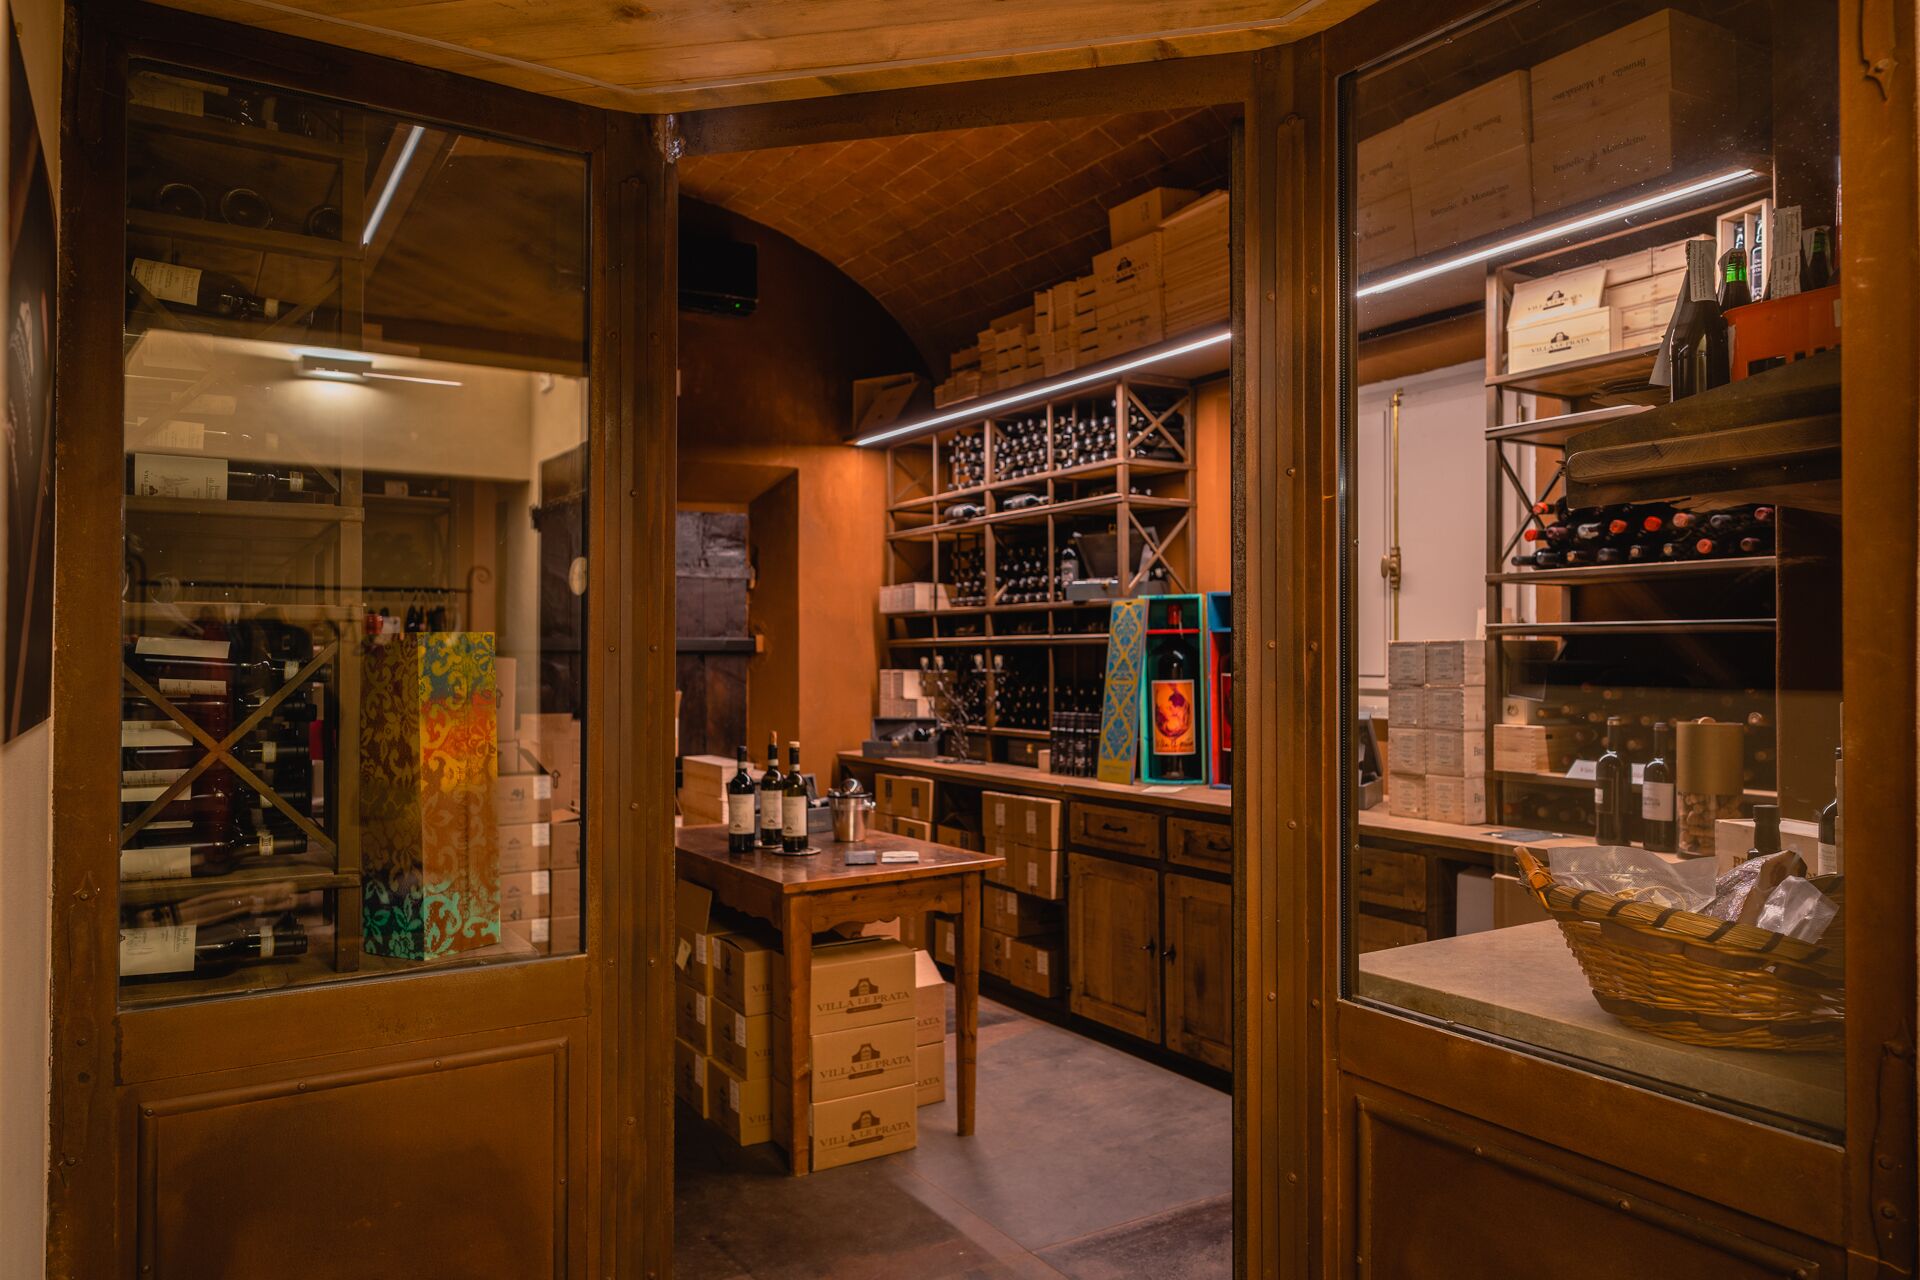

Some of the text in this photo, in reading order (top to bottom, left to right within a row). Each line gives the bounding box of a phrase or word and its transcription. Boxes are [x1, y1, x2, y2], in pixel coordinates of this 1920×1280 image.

[816, 991, 911, 1012] VILLA LE PRATA
[819, 1054, 912, 1079] VILLA LE PRATA
[819, 1120, 912, 1147] VILLA LE PRATA
